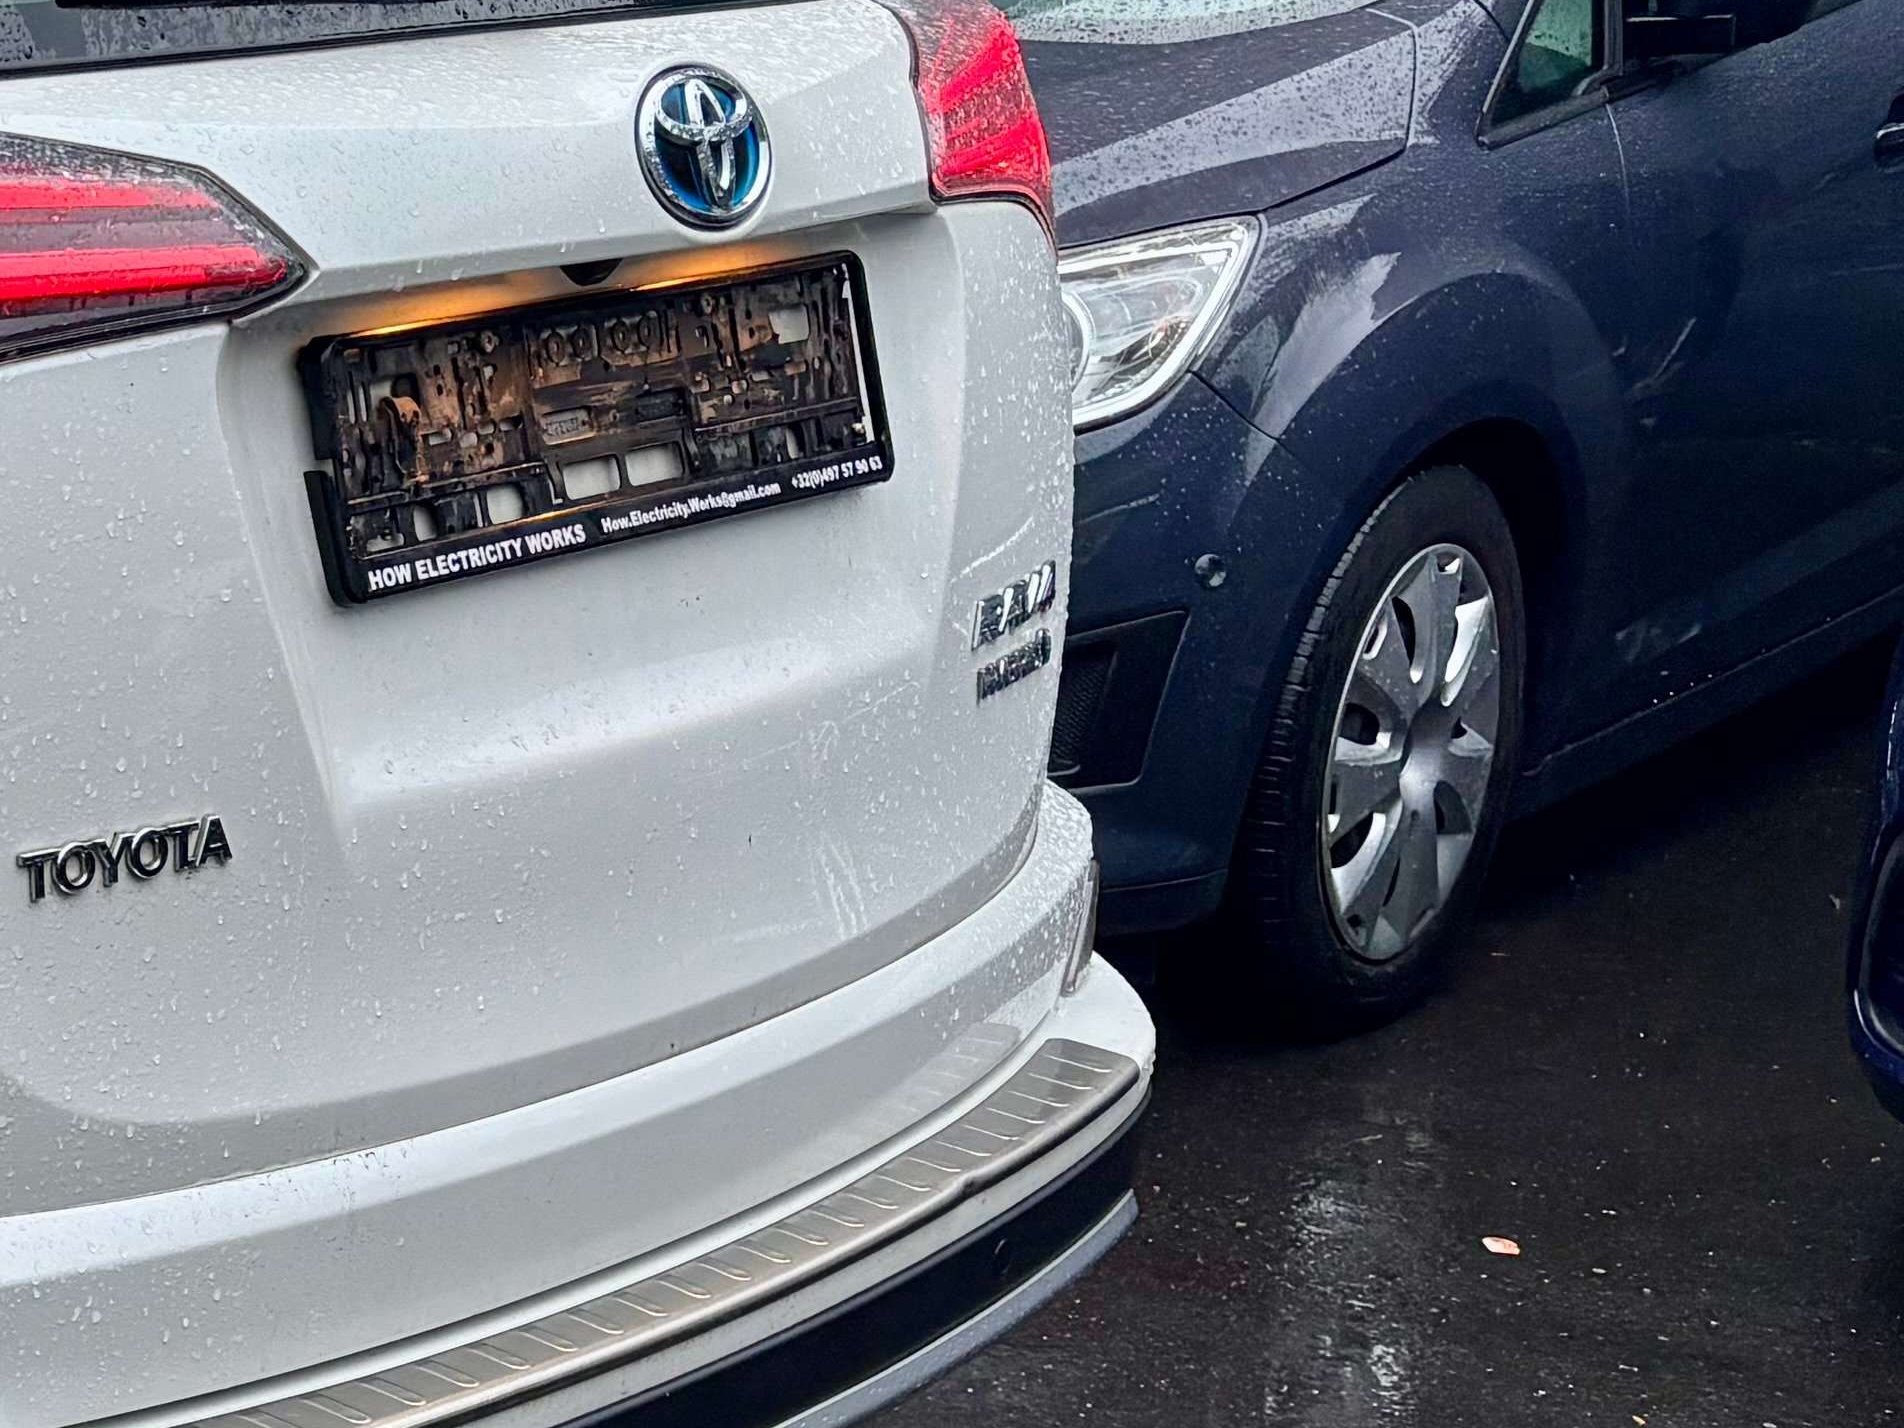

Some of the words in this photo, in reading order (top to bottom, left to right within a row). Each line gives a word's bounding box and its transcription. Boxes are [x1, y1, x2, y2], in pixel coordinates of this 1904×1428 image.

[367, 562, 412, 591] HOW
[414, 537, 523, 581] ELECTRICITY
[524, 523, 587, 555] WORKS
[15, 813, 233, 903] TOYOTA
